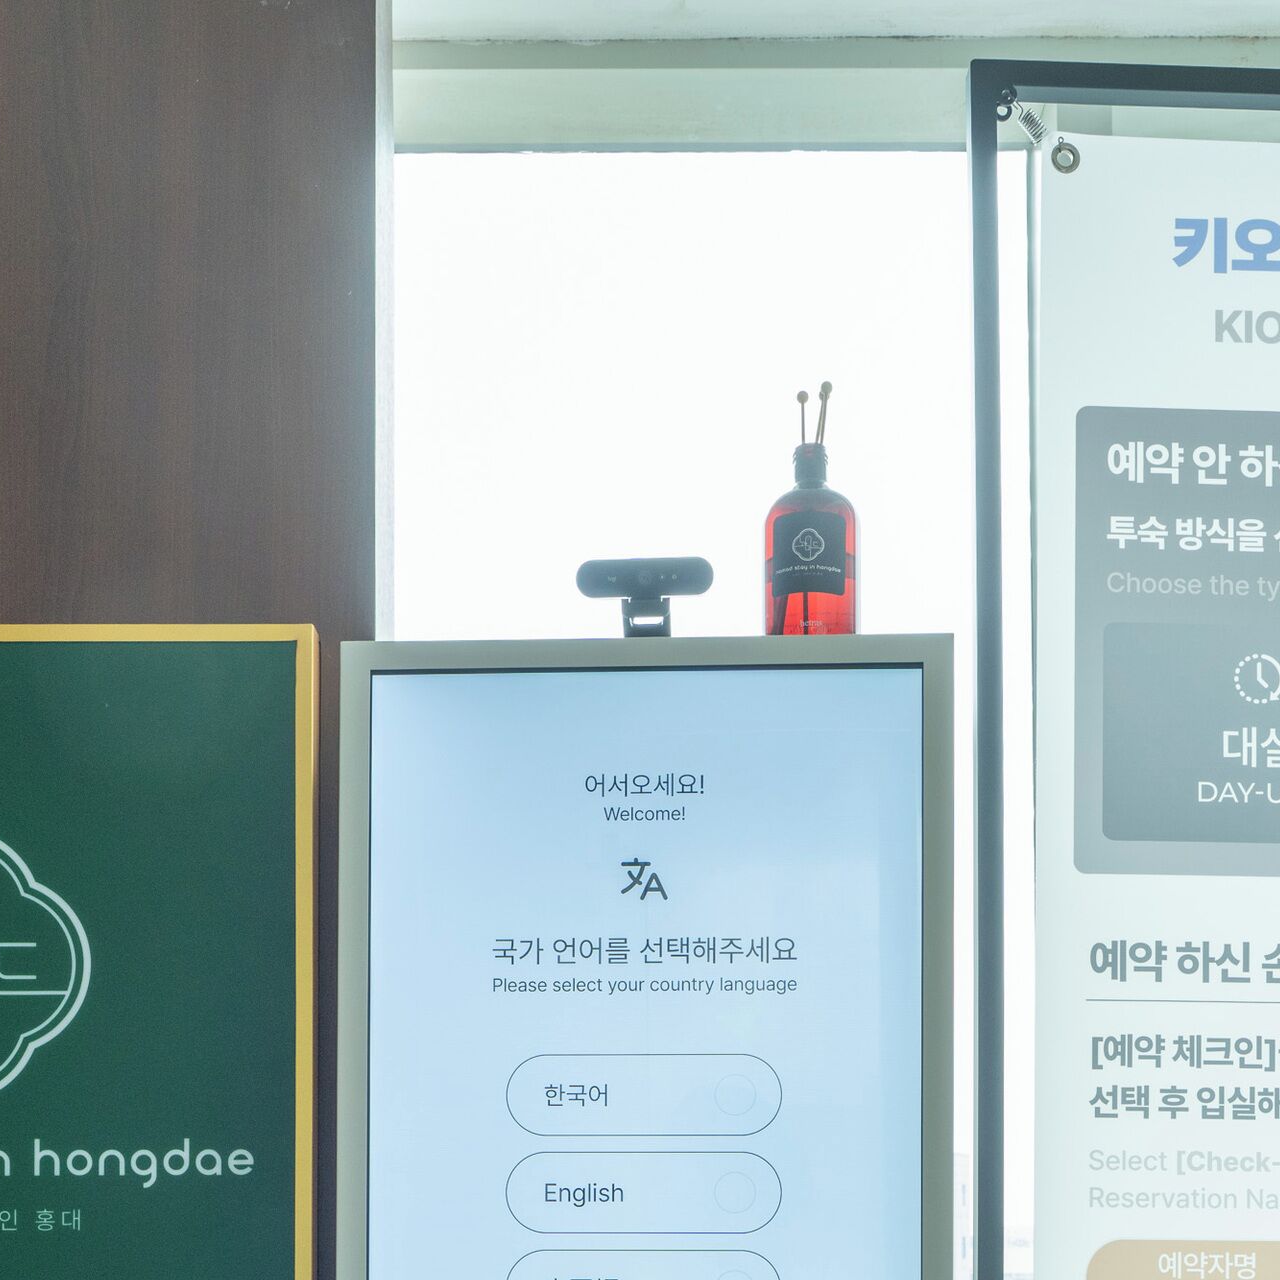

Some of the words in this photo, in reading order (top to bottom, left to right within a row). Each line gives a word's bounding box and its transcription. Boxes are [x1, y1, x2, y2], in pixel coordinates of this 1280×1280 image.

[1108, 442, 1184, 484] 예약
[1193, 444, 1231, 485] 안
[1107, 516, 1168, 549] 투숙
[1176, 517, 1266, 552] 방식을
[1107, 572, 1201, 594] Choose
[1209, 575, 1249, 595] the
[585, 773, 704, 797] 어서오세요!
[604, 807, 685, 821] Welcome!
[493, 938, 543, 965] 국가
[553, 938, 630, 964] 언어를
[640, 937, 797, 964] 선택해주세요
[1090, 940, 1167, 982] 예약
[1176, 941, 1250, 983] 하신
[493, 978, 547, 992] Please
[553, 978, 602, 992] select
[608, 981, 645, 995] your
[650, 978, 714, 995] country
[721, 977, 797, 995] language
[1092, 1034, 1165, 1069] [예약
[545, 1084, 607, 1106] 한국어
[34, 1138, 254, 1188] hongdae
[1089, 1150, 1167, 1171] Select
[545, 1183, 623, 1207] English
[1089, 1187, 1237, 1208] Reservation
[0, 1209, 17, 1230] 인
[36, 1209, 80, 1231] 홍대
[1159, 1252, 1256, 1279] 예약자명
